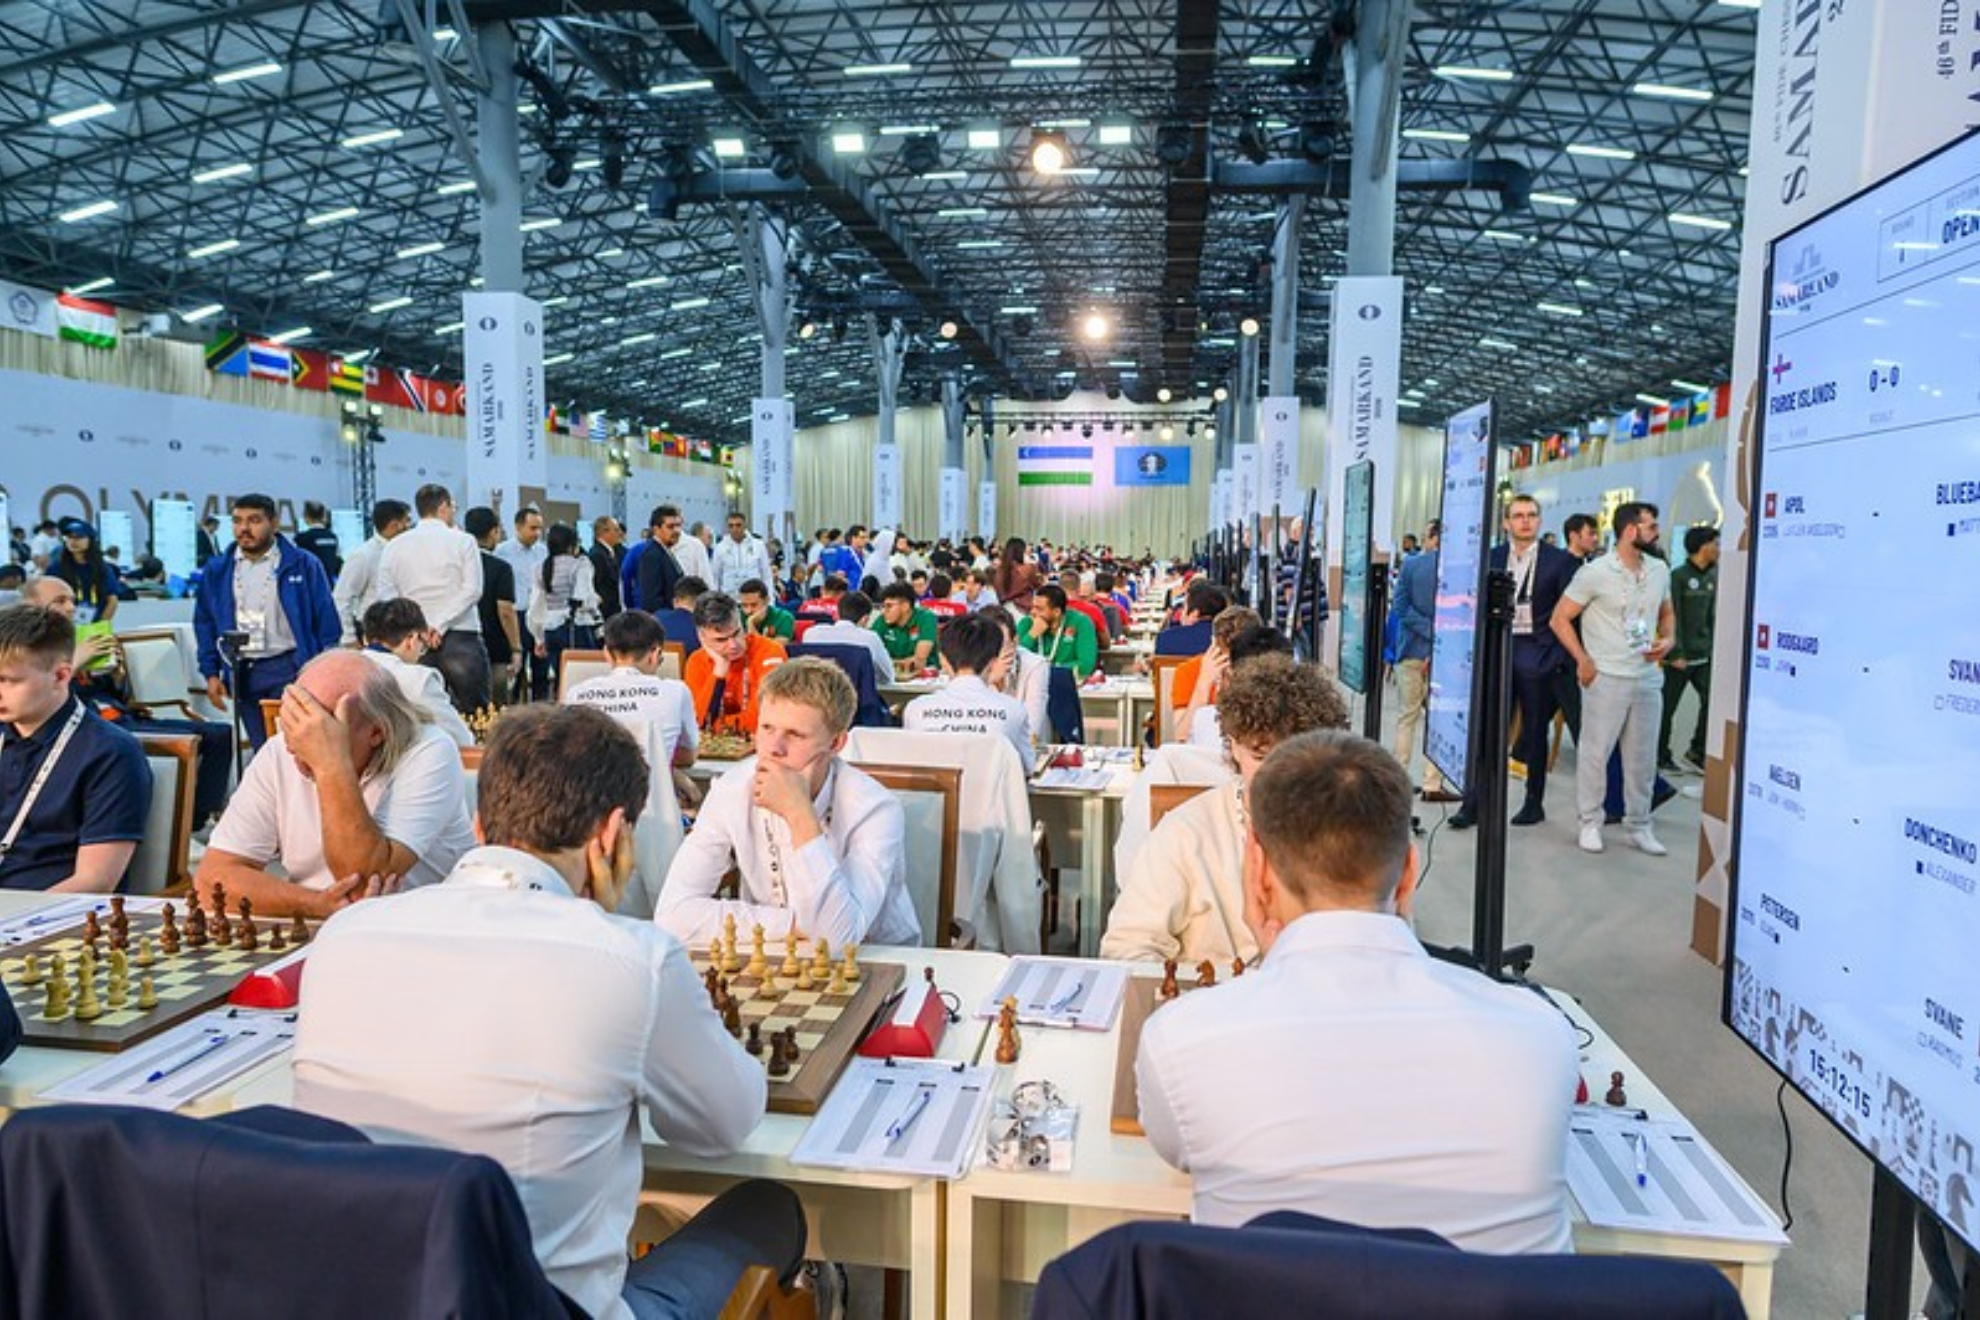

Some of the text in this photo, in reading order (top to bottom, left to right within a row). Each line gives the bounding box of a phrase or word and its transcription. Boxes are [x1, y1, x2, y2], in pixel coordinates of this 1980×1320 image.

[482, 362, 496, 459] SAMARKAND
[1354, 355, 1373, 460] SAMARKAND
[577, 687, 659, 700] HONG KONG
[603, 701, 638, 713] HINA
[923, 709, 1007, 720] HONG KONG
[1904, 817, 1977, 864] DONCHENKO
[1924, 997, 1964, 1040] SVANE
[1809, 1049, 1871, 1118] 15:12:15
